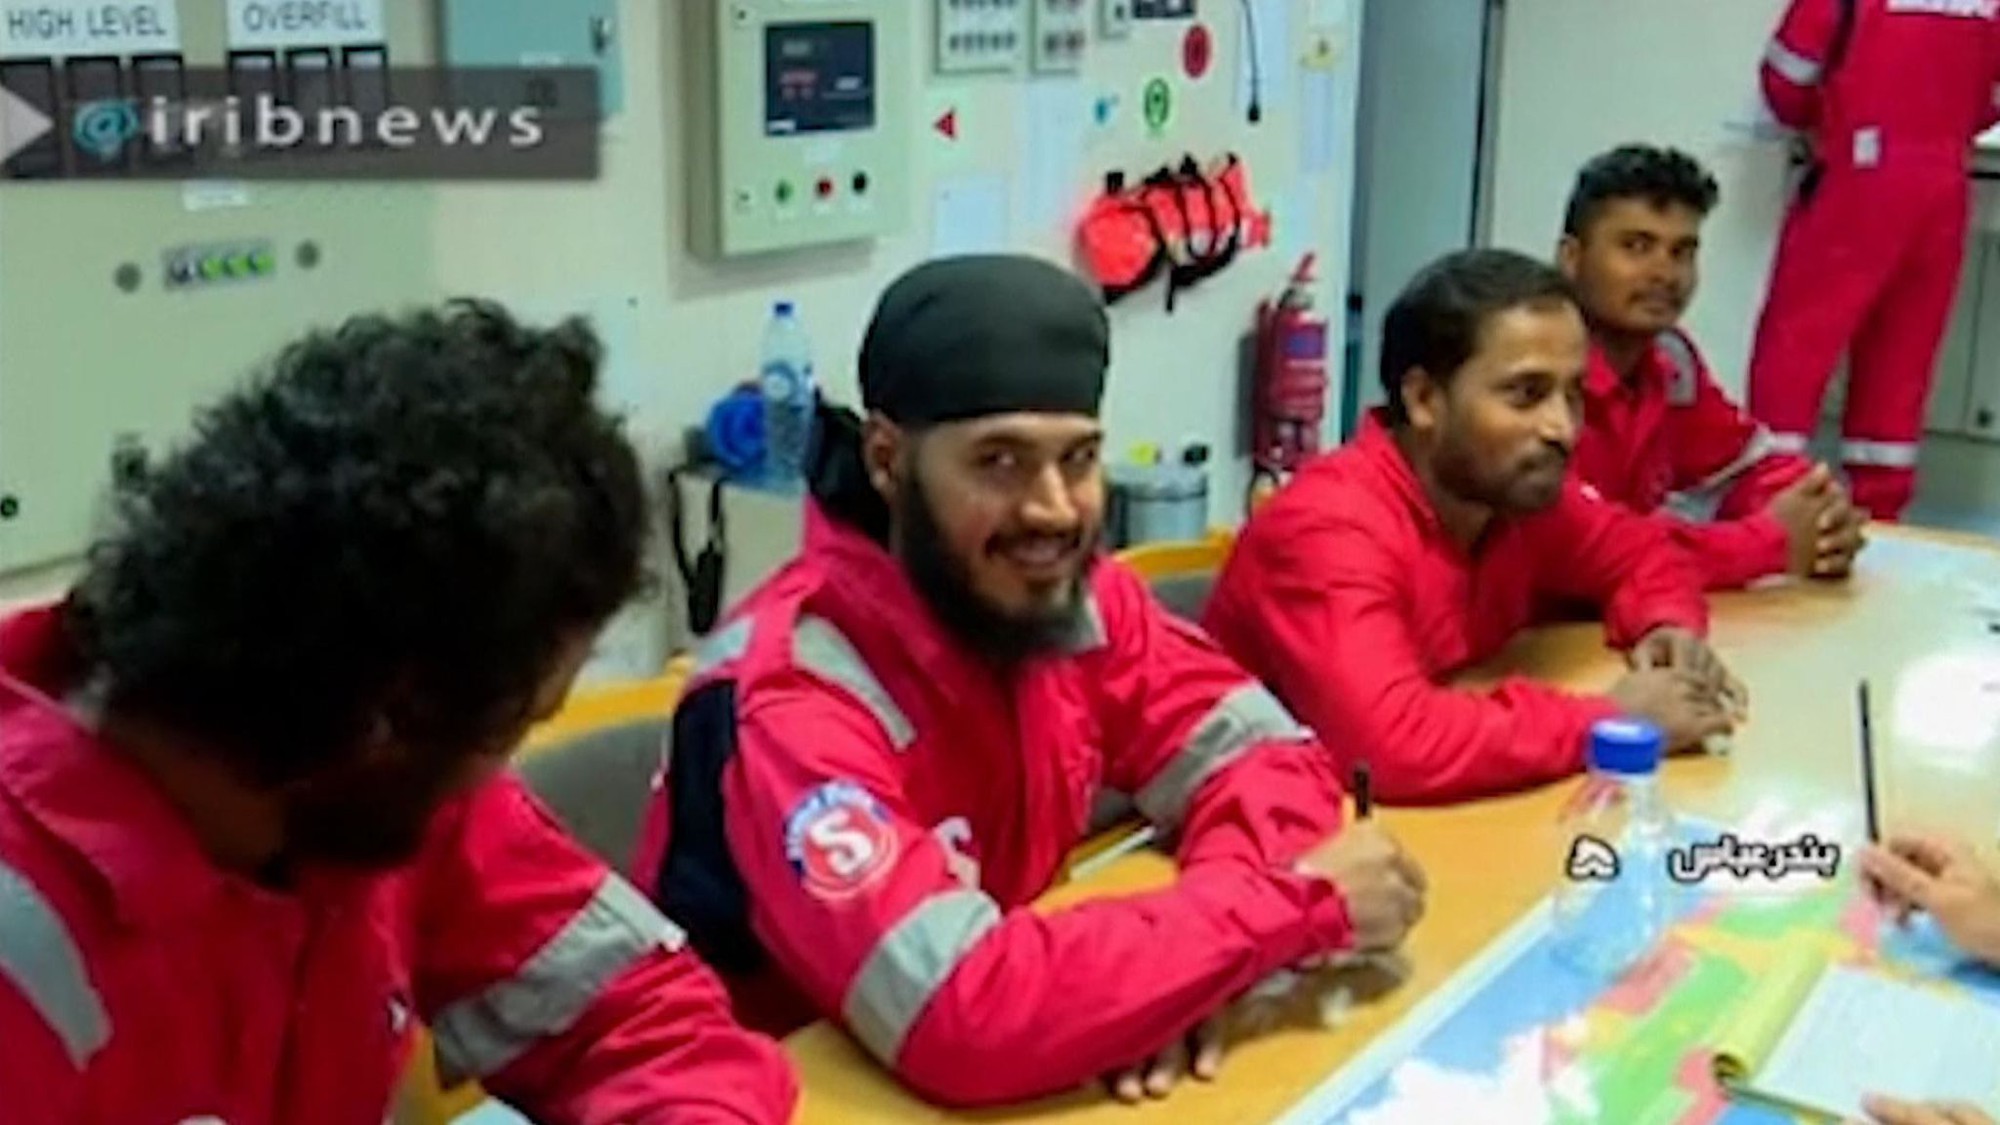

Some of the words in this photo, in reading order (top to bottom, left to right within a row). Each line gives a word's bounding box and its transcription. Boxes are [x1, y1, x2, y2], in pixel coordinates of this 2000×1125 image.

[9, 9, 73, 39] HIGH
[87, 5, 167, 36] LEVEL
[243, 0, 367, 31] OVERFILL
[809, 808, 874, 876] S
